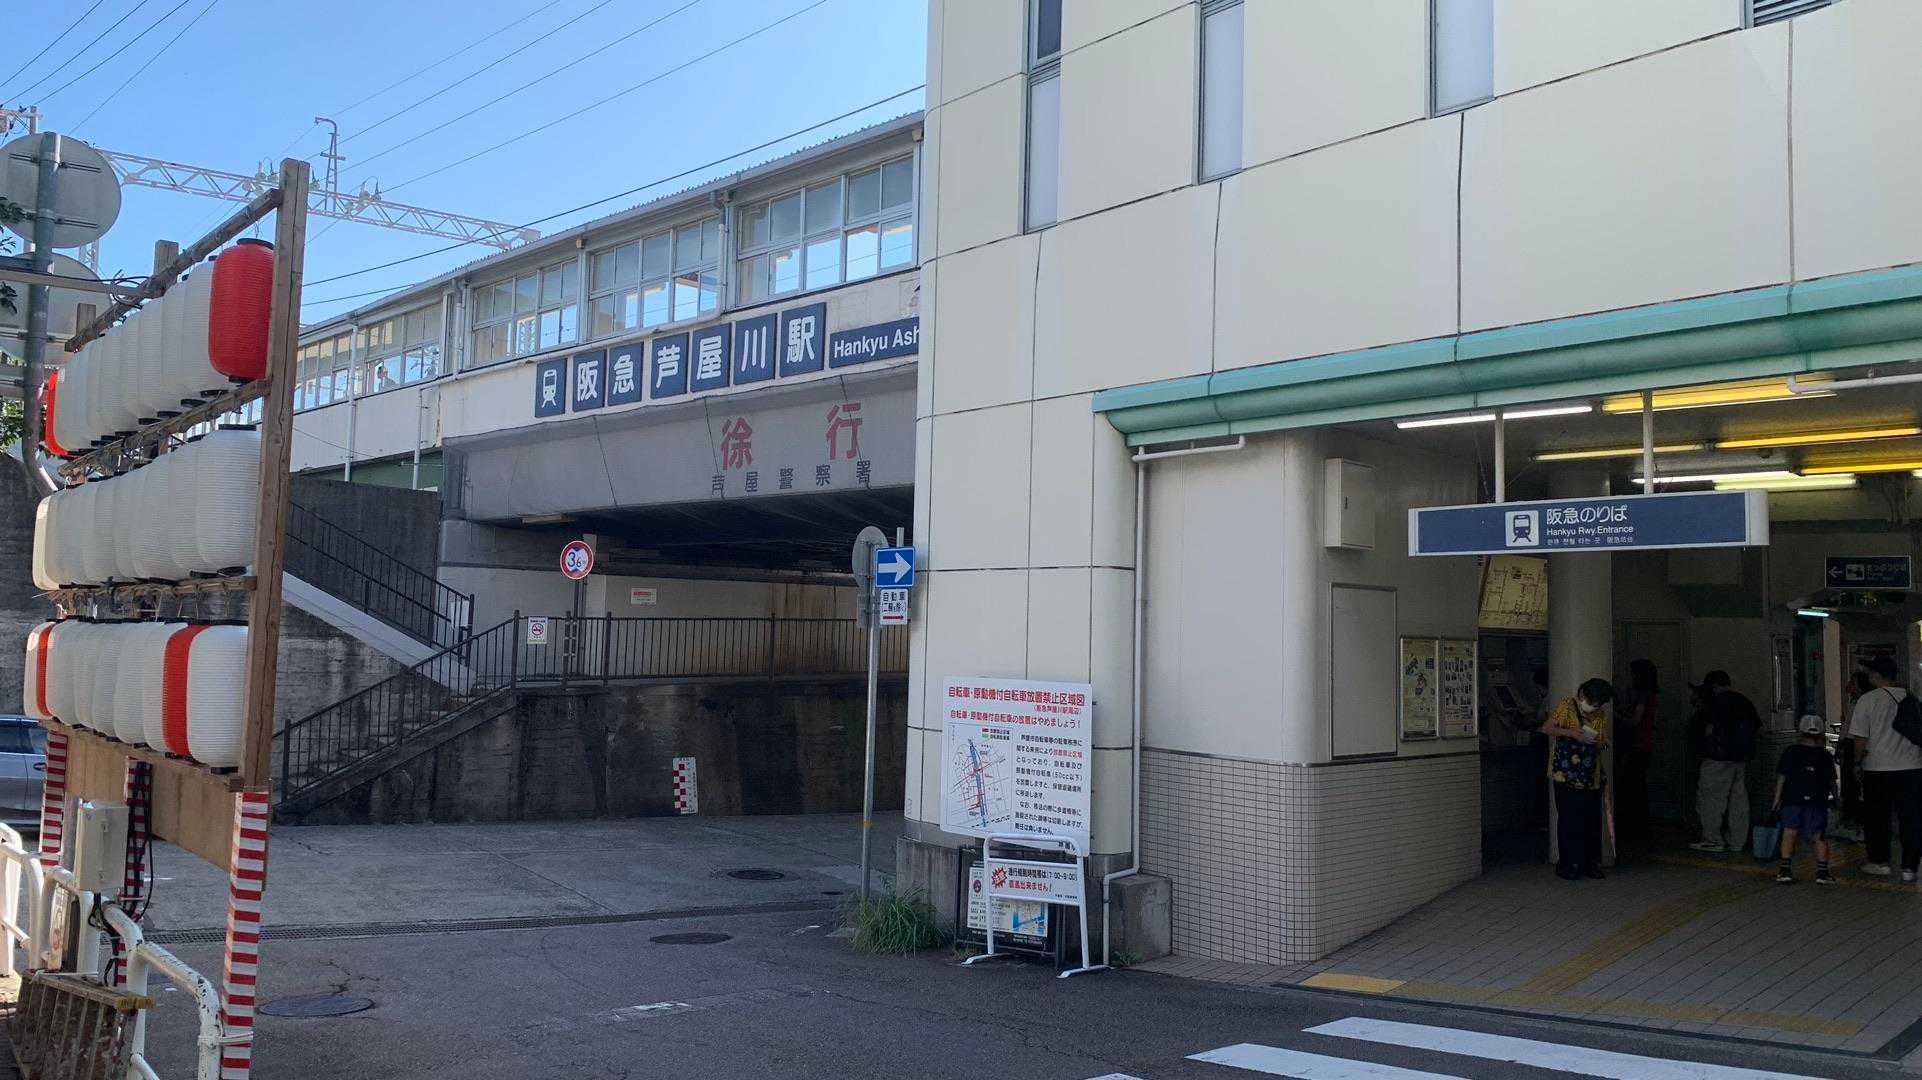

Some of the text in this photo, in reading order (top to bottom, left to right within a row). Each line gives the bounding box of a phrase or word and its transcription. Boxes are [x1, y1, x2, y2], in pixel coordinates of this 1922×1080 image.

[577, 315, 816, 402] 阪急芦屋川駅
[834, 335, 888, 358] Hankyu
[720, 403, 863, 471] 徐行
[712, 460, 871, 496] 芦屋警察署
[1546, 504, 1628, 525] 阪急のりば
[1546, 528, 1576, 537] Hankyu
[1597, 525, 1634, 534] Entrance
